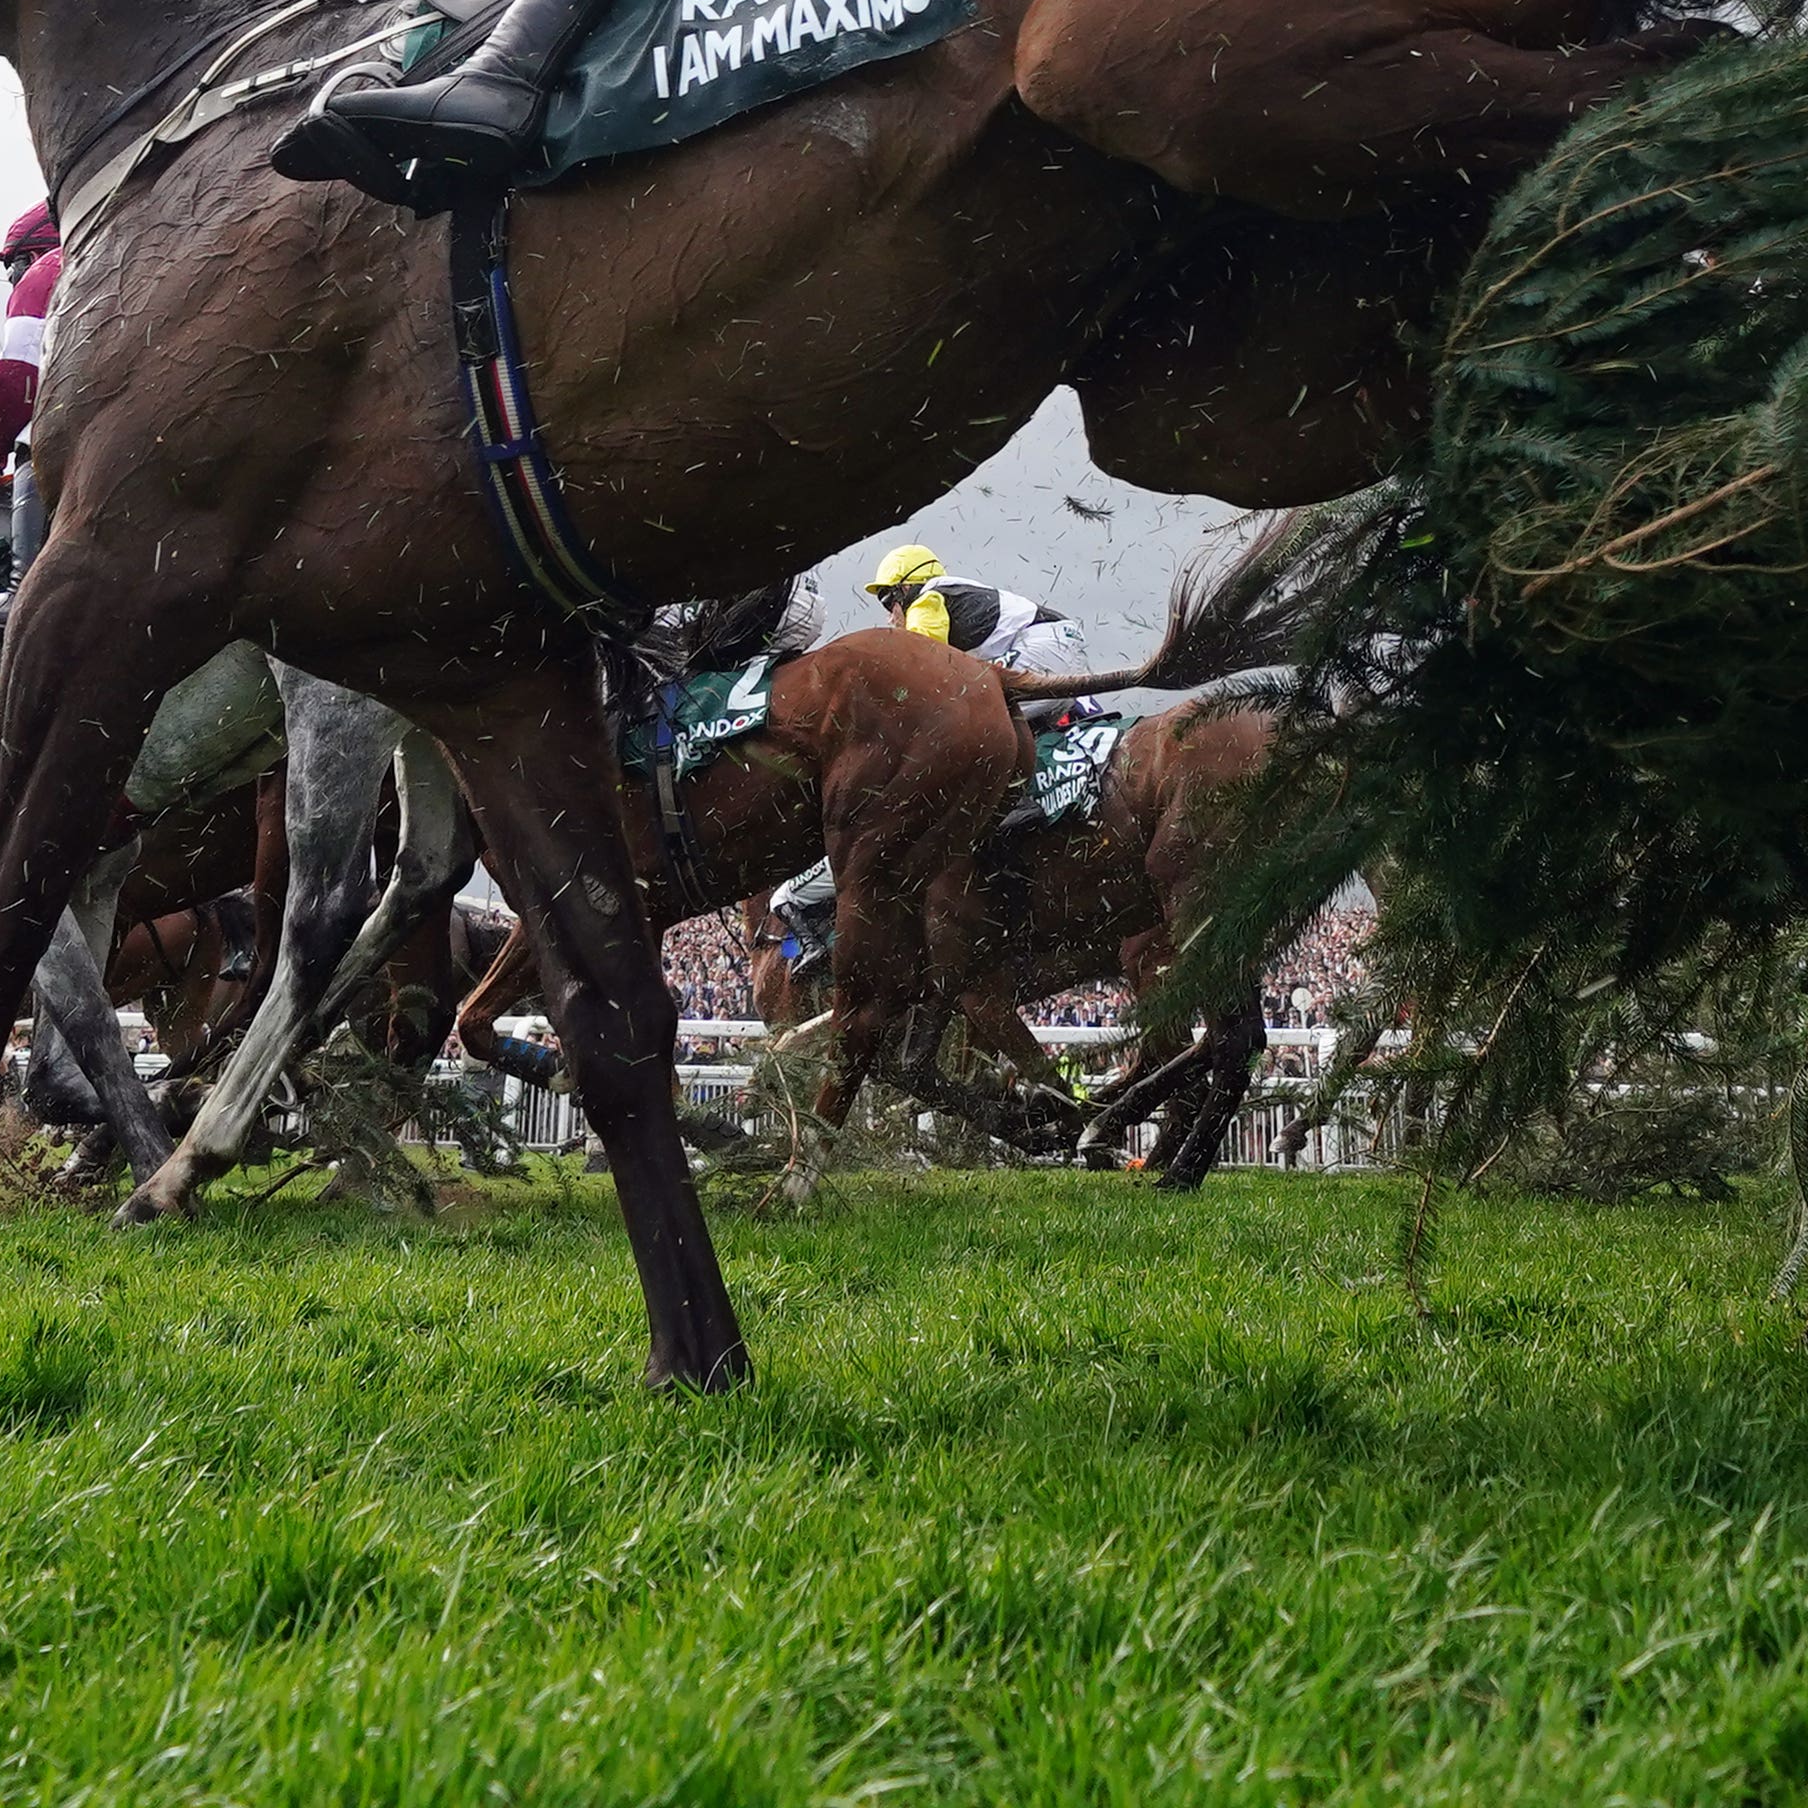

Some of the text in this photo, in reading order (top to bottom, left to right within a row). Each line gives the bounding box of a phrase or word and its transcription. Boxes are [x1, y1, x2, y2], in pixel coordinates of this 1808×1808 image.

[653, 45, 670, 99] I
[678, 24, 743, 97] AM
[675, 707, 768, 744] RANDOX
[1052, 725, 1118, 765] 30
